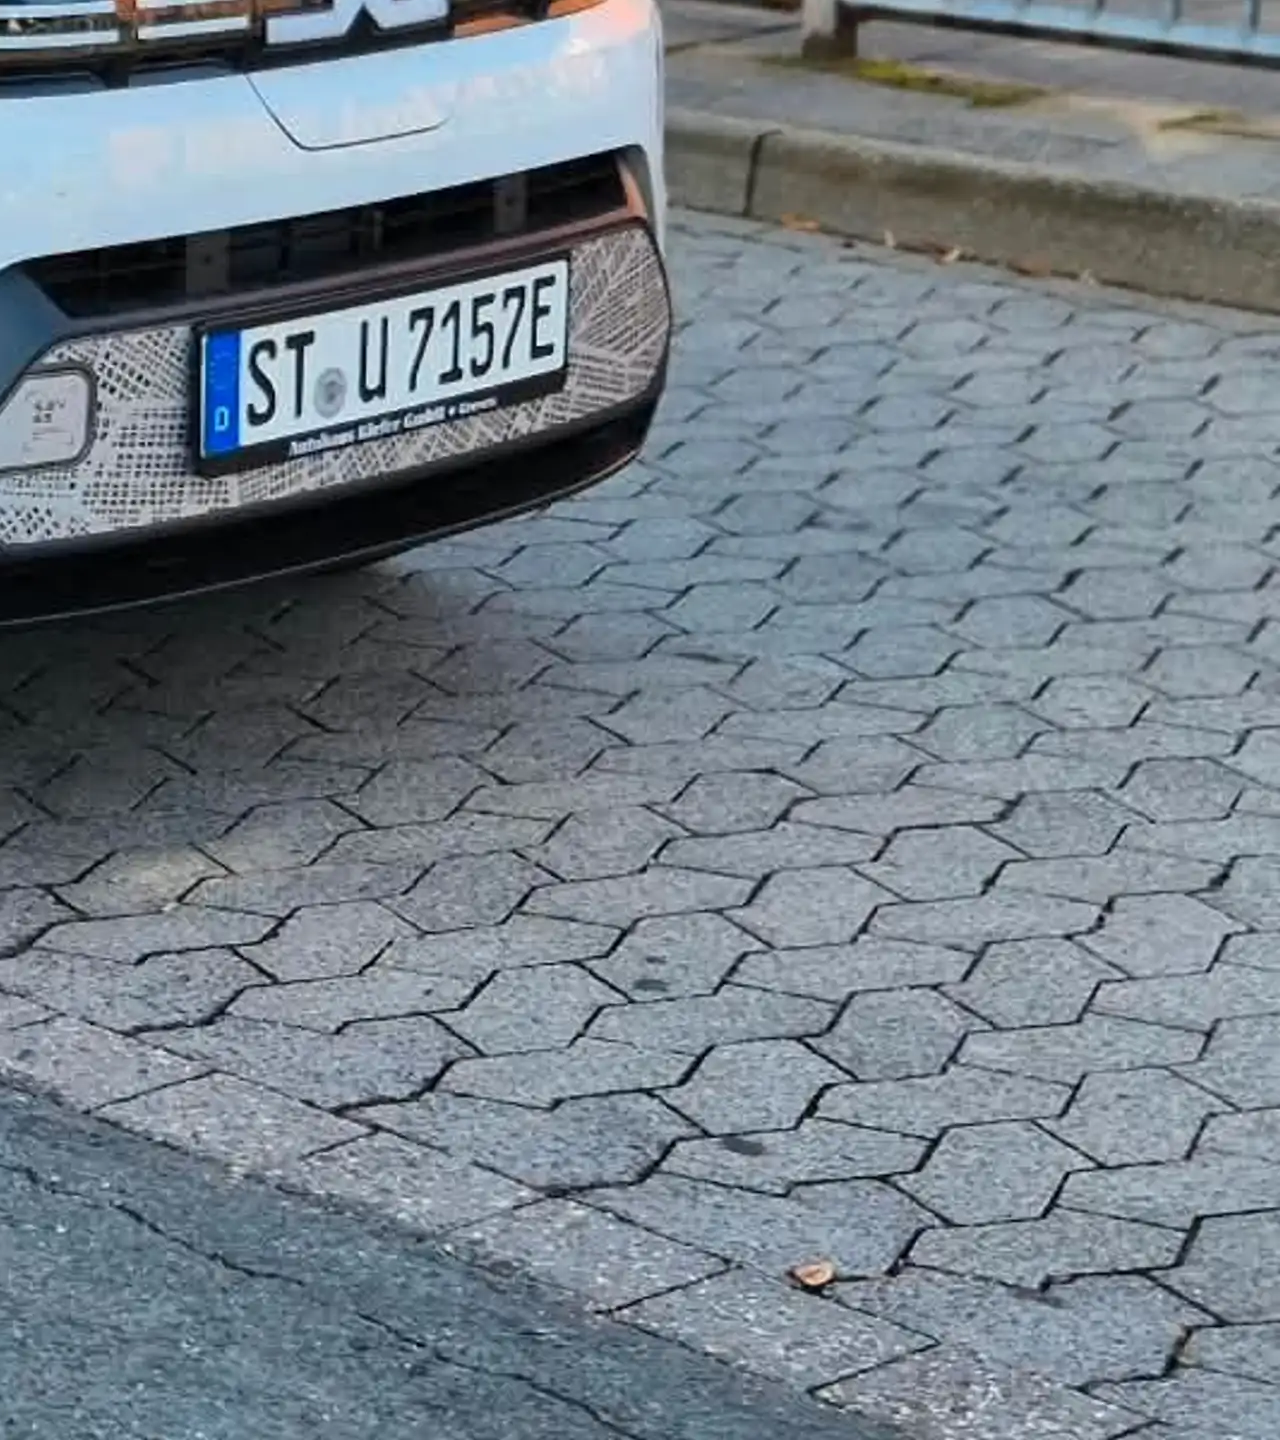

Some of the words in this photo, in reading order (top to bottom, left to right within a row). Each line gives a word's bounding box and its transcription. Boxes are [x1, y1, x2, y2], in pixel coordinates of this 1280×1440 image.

[246, 329, 315, 427] ST
[358, 315, 389, 404] U
[408, 274, 556, 393] 7157E
